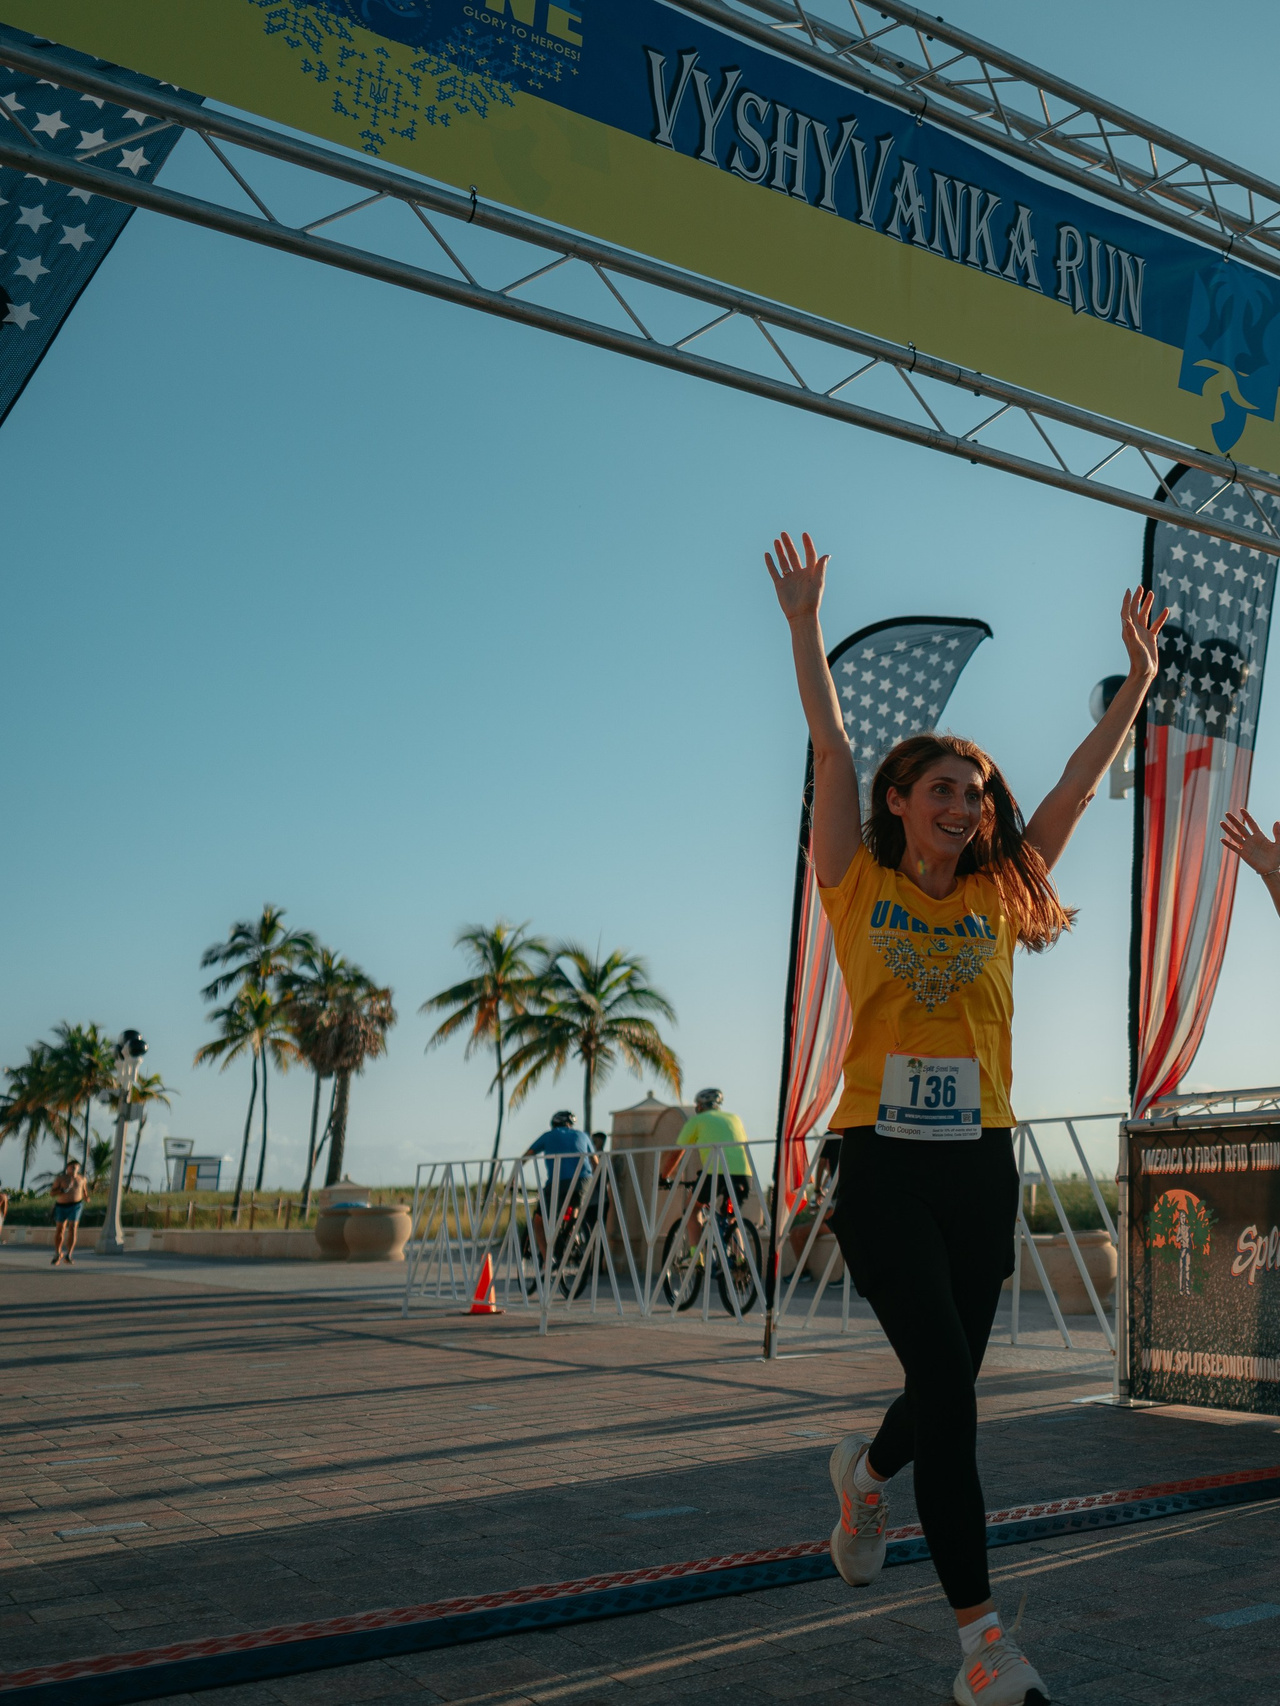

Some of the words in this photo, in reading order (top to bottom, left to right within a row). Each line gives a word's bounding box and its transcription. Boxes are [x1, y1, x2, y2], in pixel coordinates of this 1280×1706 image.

[463, 5, 506, 29] GLORY
[509, 24, 527, 39] TO
[530, 34, 582, 62] HEROES!
[644, 48, 1041, 293] VYSHYVANKA
[1056, 223, 1147, 333] RUN
[908, 1074, 956, 1108] 136
[878, 1124, 896, 1133] Photo
[897, 1126, 920, 1136] Coupon
[1141, 1147, 1192, 1175] AMERICA'S
[1194, 1146, 1222, 1174] FIRST
[1224, 1144, 1248, 1173] RFID
